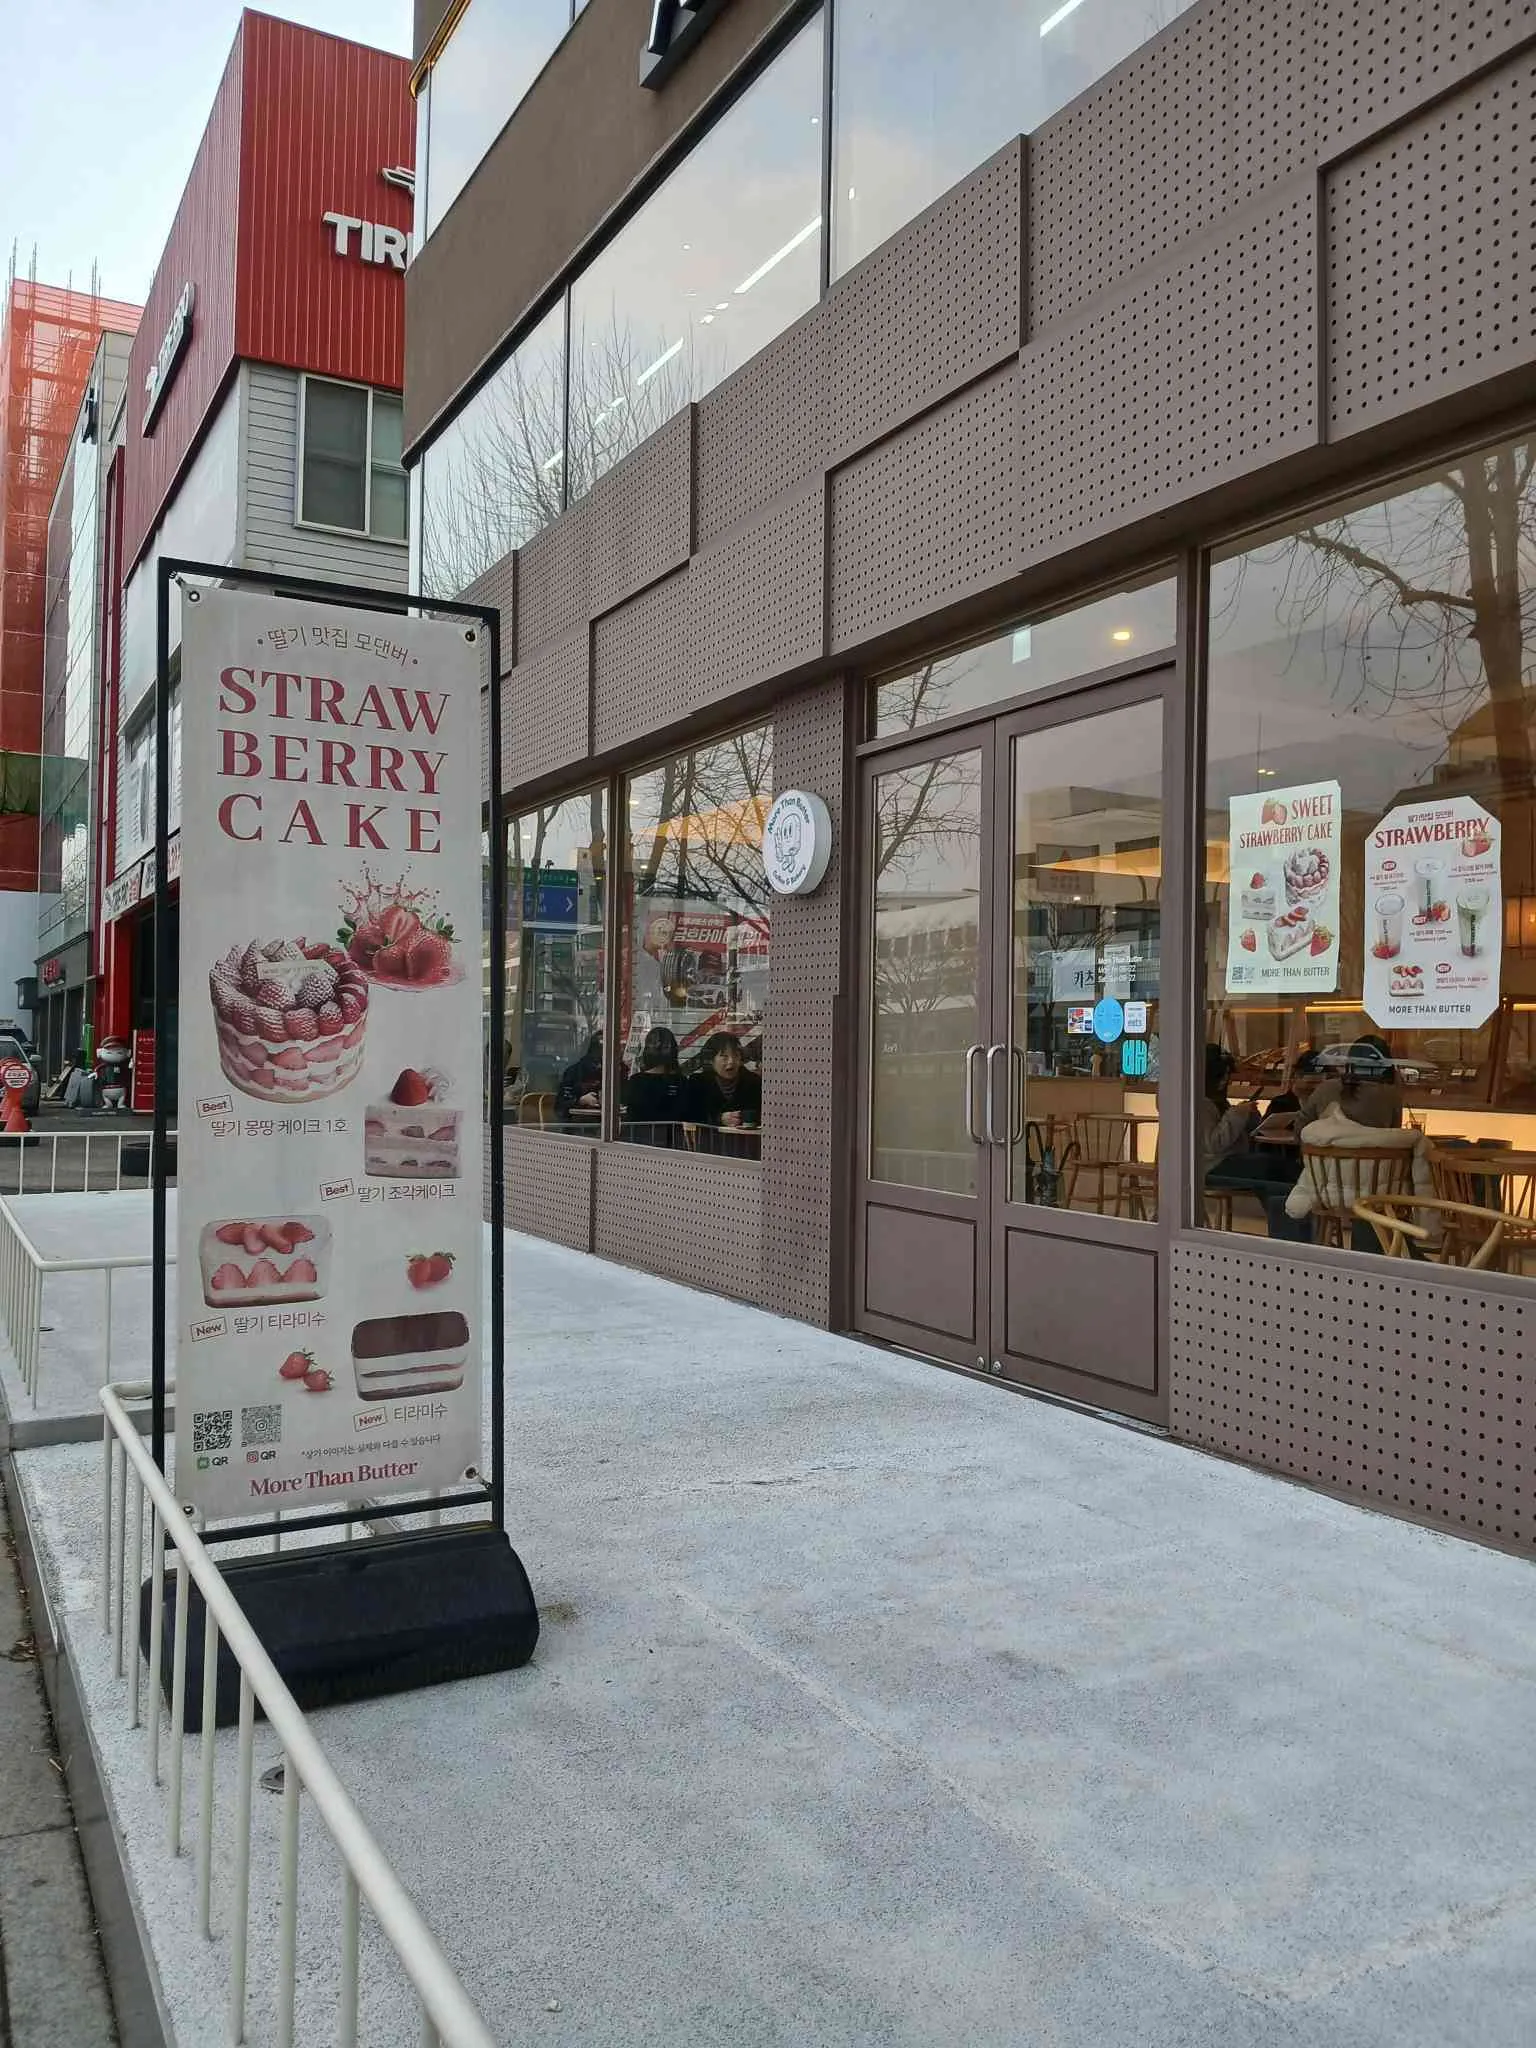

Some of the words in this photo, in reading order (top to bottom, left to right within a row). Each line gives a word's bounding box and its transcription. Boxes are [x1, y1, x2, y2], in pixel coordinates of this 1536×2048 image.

[266, 626, 308, 651] 딸기
[311, 626, 350, 649] 맛집
[354, 632, 410, 666] 모댄버
[218, 666, 452, 736] STRAW
[217, 729, 449, 796] BERRY
[1291, 794, 1334, 819] SWEET
[217, 793, 442, 854] CAKE
[1239, 824, 1304, 850] STRAWBERRY
[1307, 821, 1333, 841] CAKE
[1261, 967, 1281, 977] MORE
[1283, 967, 1301, 977] THAN
[1303, 966, 1330, 977] BUTTER
[1388, 1004, 1414, 1014] MORE
[1415, 1004, 1436, 1014] THAN
[1438, 1003, 1471, 1013] BUTTER
[201, 1100, 228, 1115] Best
[211, 1120, 241, 1137] 딸기
[244, 1119, 274, 1136] 몽땅
[277, 1119, 321, 1135] 케이크
[325, 1118, 350, 1133] 1호
[325, 1183, 350, 1196] Best
[357, 1186, 386, 1203] 딸기
[387, 1184, 457, 1201] 조각케이크
[195, 1322, 224, 1338] New
[233, 1316, 264, 1335] 딸기
[268, 1311, 328, 1330] 티라미수
[358, 1413, 384, 1428] New
[393, 1402, 450, 1423] 티라미수
[211, 1456, 229, 1467] QR
[260, 1450, 277, 1461] QR
[249, 1477, 302, 1497] More
[305, 1469, 354, 1488] Than
[357, 1462, 418, 1482] Butter
